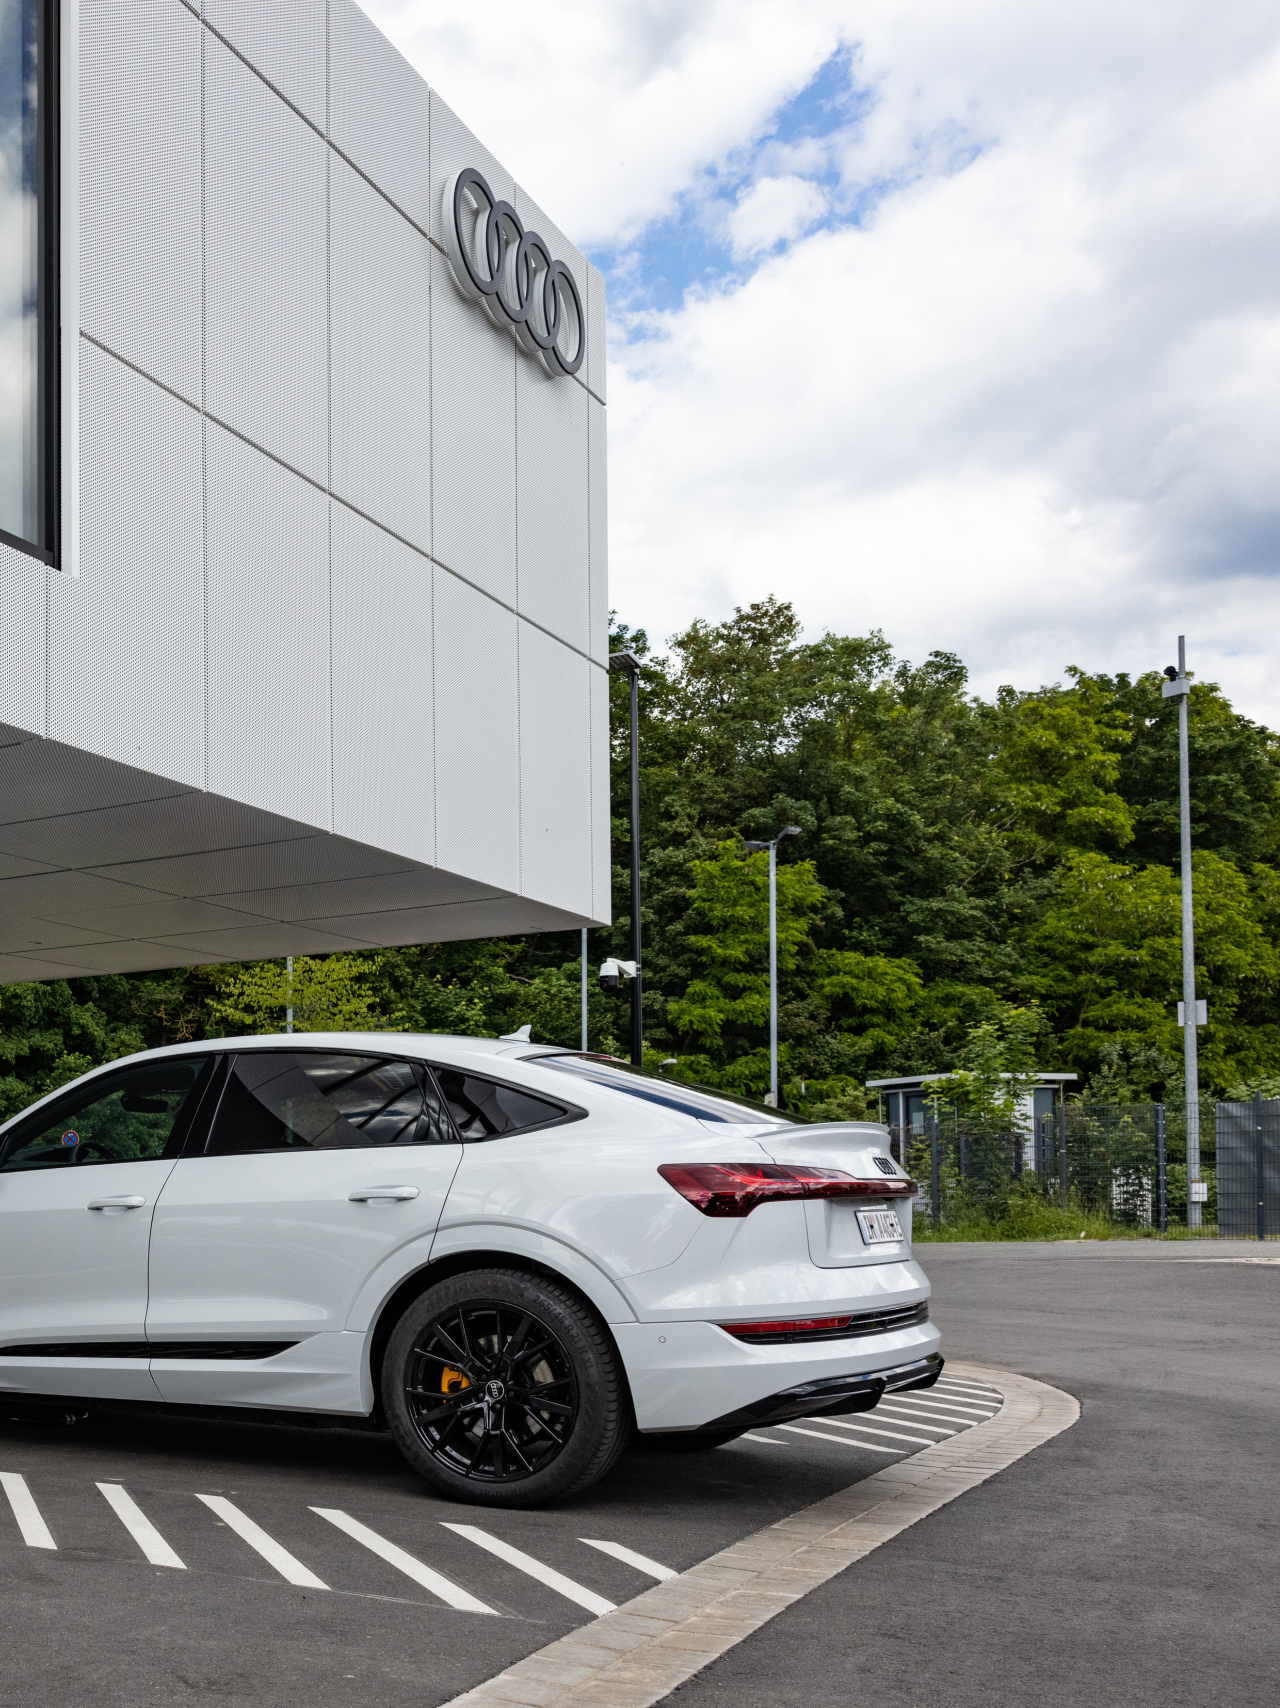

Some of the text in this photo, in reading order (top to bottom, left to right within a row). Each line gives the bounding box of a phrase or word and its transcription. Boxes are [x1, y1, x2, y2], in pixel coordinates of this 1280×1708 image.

[532, 1294, 568, 1325] 265/45
[563, 1321, 576, 1334] R
[570, 1330, 584, 1345] 21
